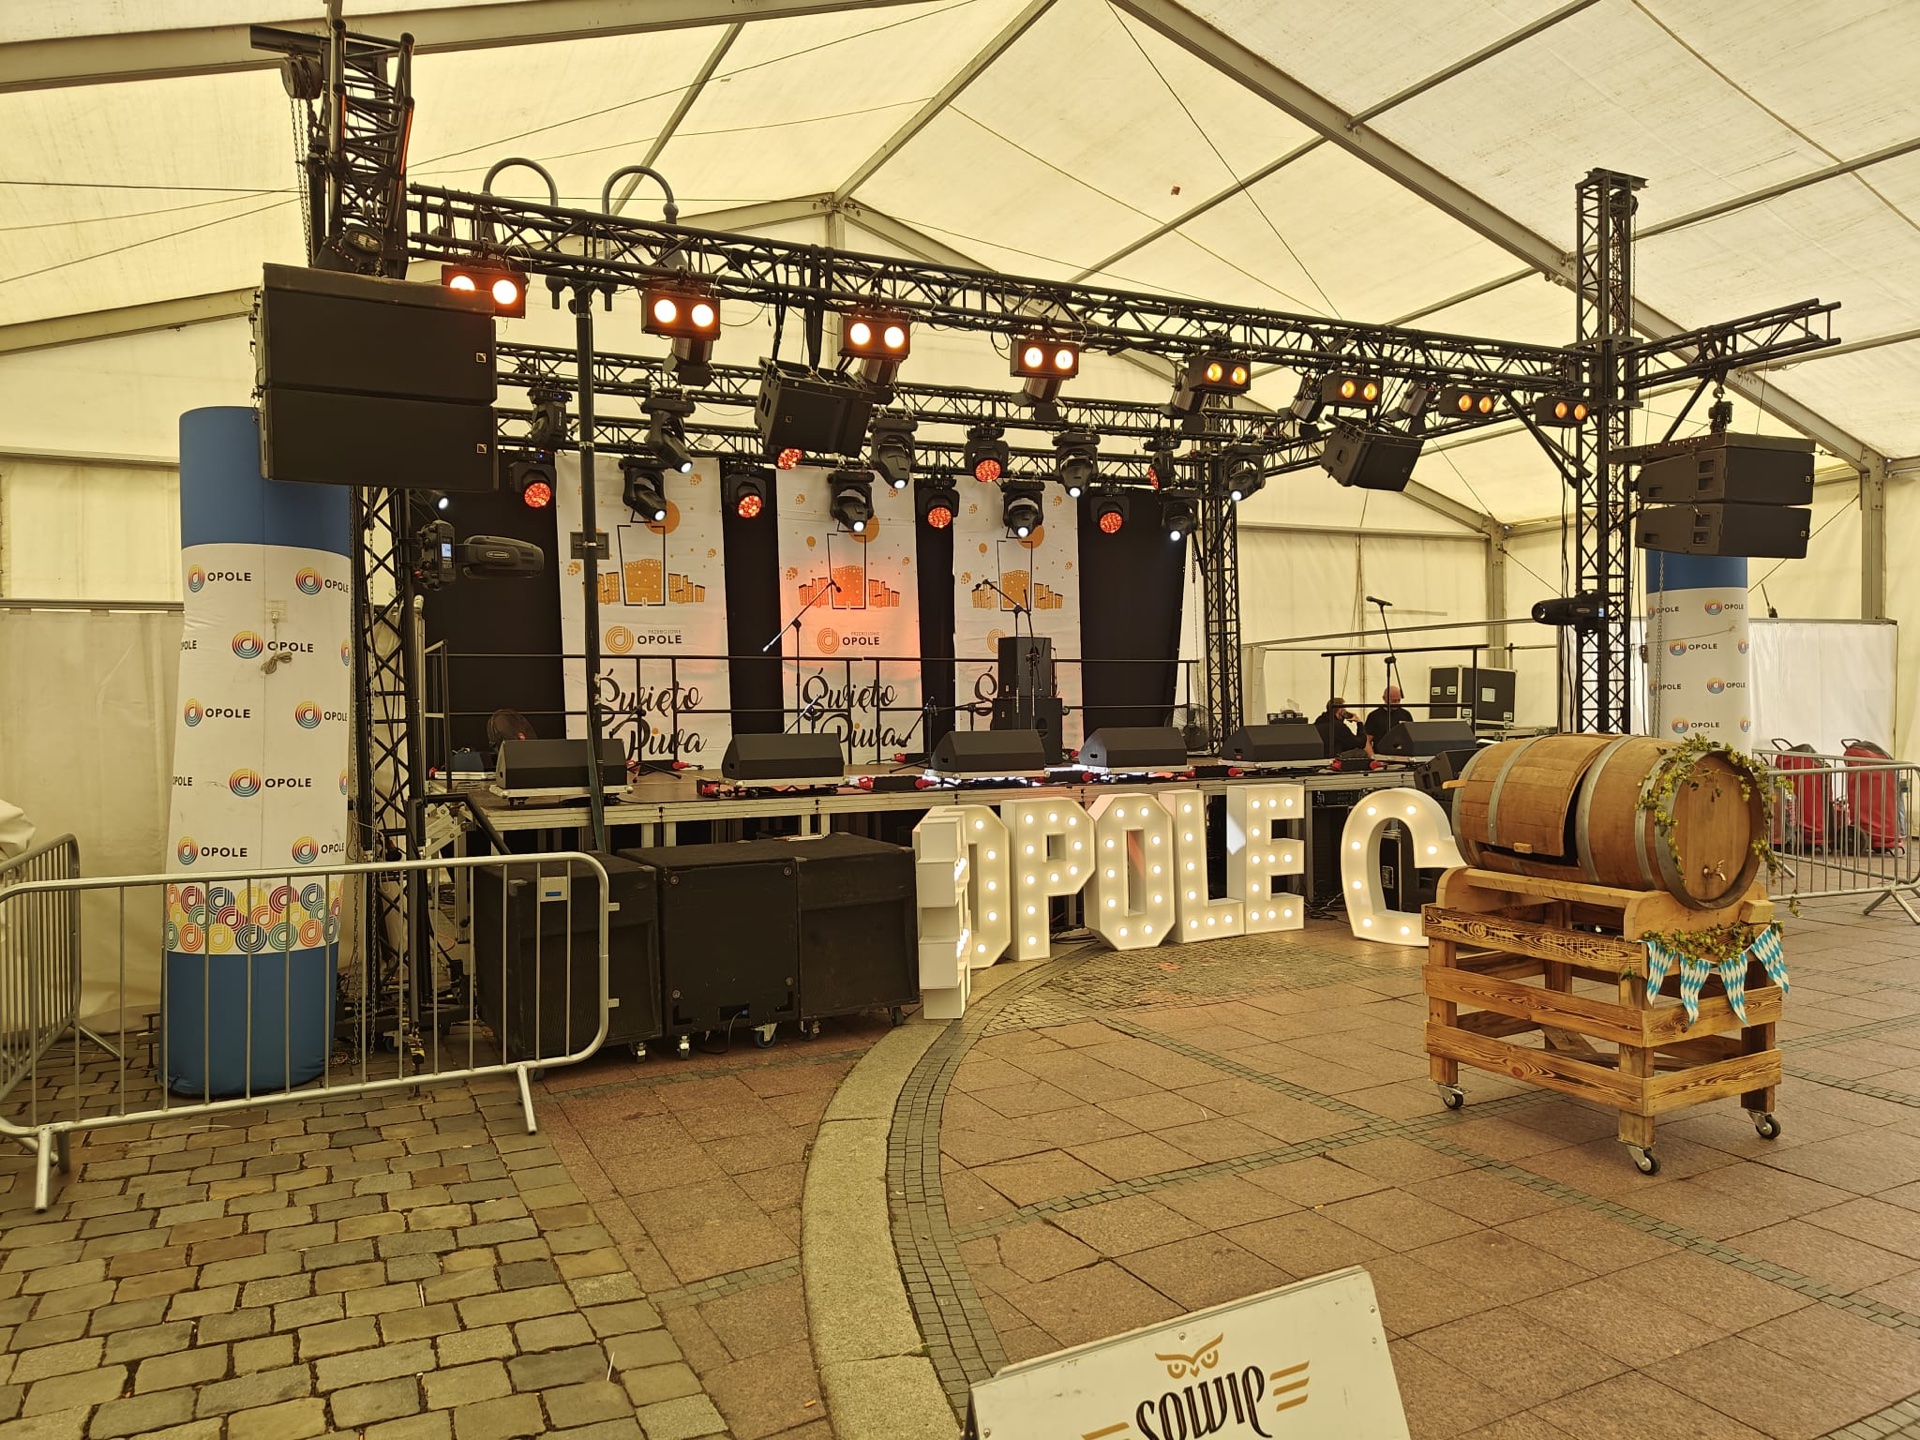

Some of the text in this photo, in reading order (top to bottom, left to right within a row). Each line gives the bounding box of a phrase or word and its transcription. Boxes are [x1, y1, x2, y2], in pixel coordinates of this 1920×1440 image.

[207, 571, 252, 582] OPOLE
[324, 578, 349, 593] OPOLE
[180, 640, 197, 651] POLE
[637, 635, 682, 645] OPOLE
[842, 636, 880, 645] OPOLE
[267, 641, 314, 653] OPOLE
[1688, 643, 1718, 651] OPOLE
[802, 668, 898, 722] Święto
[205, 707, 251, 719] OPOLE
[324, 709, 348, 721] OPOLE
[617, 716, 708, 760] Piwa
[265, 777, 312, 788] OPOLE
[200, 847, 248, 858] OPOLE
[321, 842, 345, 854] OPOLE
[913, 783, 1304, 968] OPOLE
